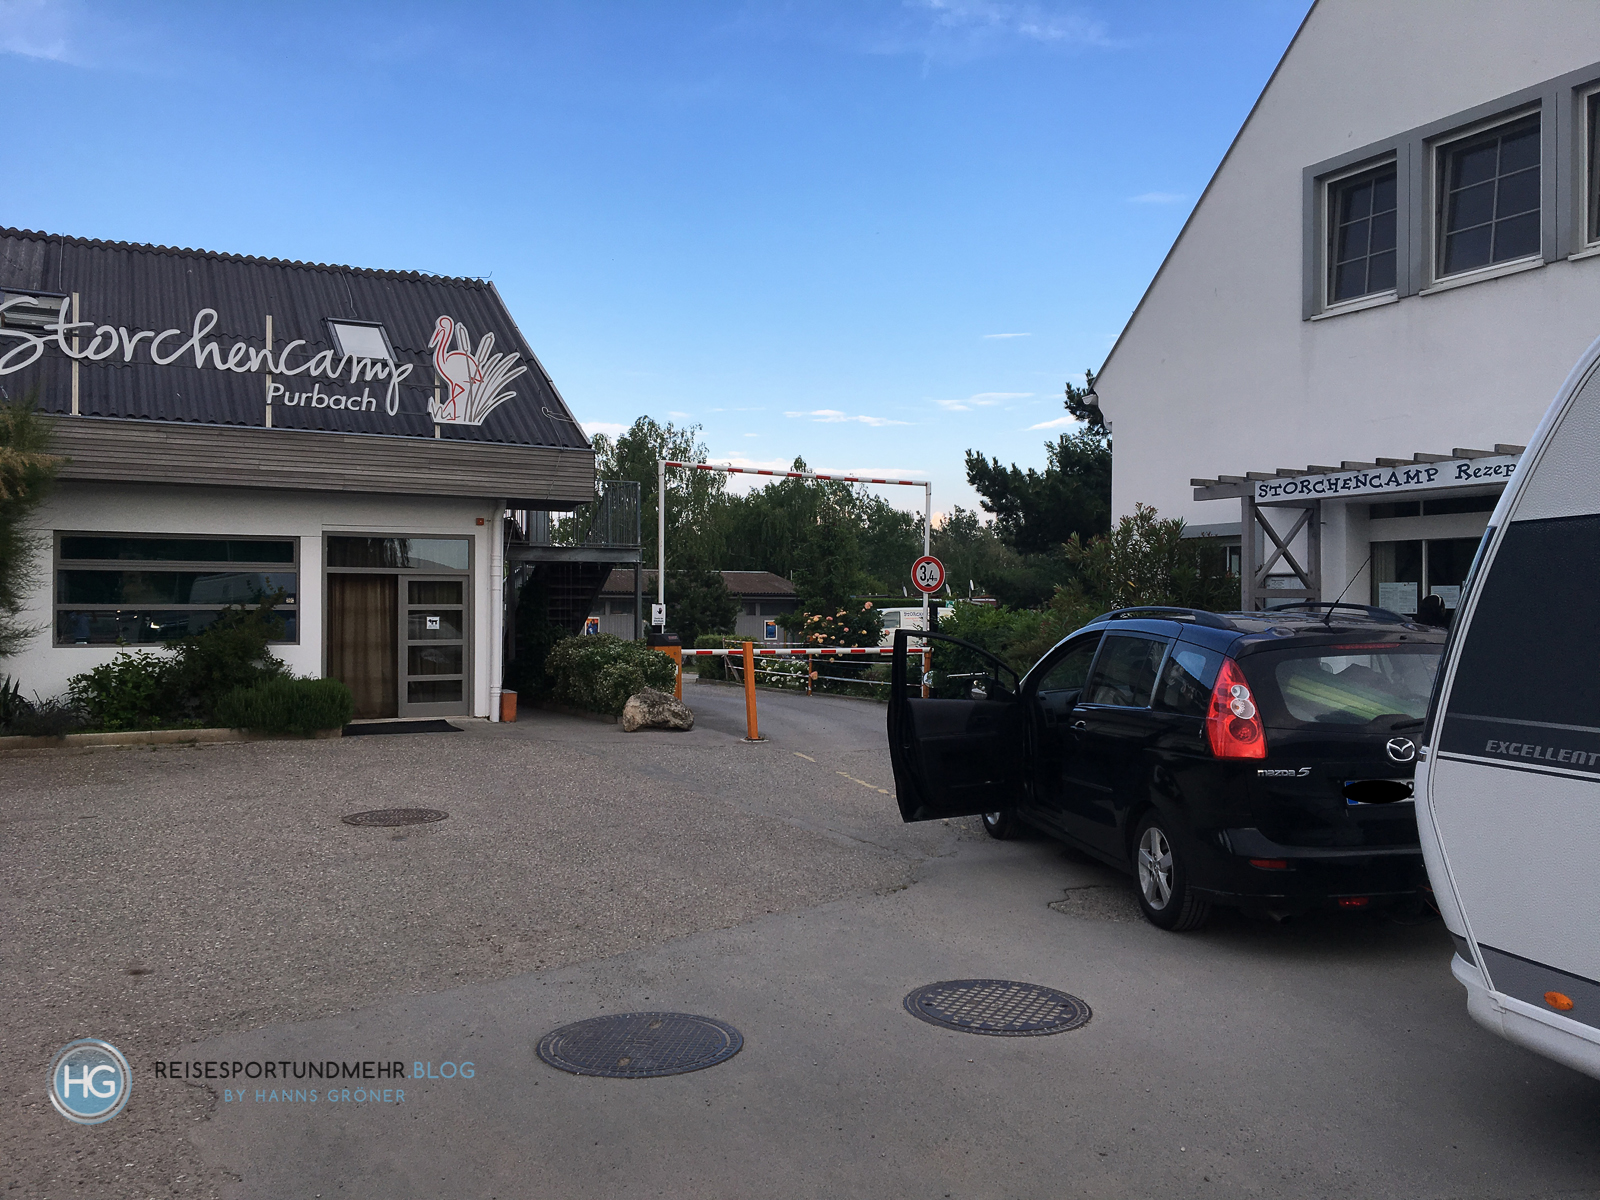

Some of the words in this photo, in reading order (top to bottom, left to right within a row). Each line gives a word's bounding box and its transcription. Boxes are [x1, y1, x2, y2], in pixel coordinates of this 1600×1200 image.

[266, 382, 377, 412] Purbach
[1258, 467, 1439, 498] STORCHENCAMP
[1485, 739, 1600, 766] EXCELLENT
